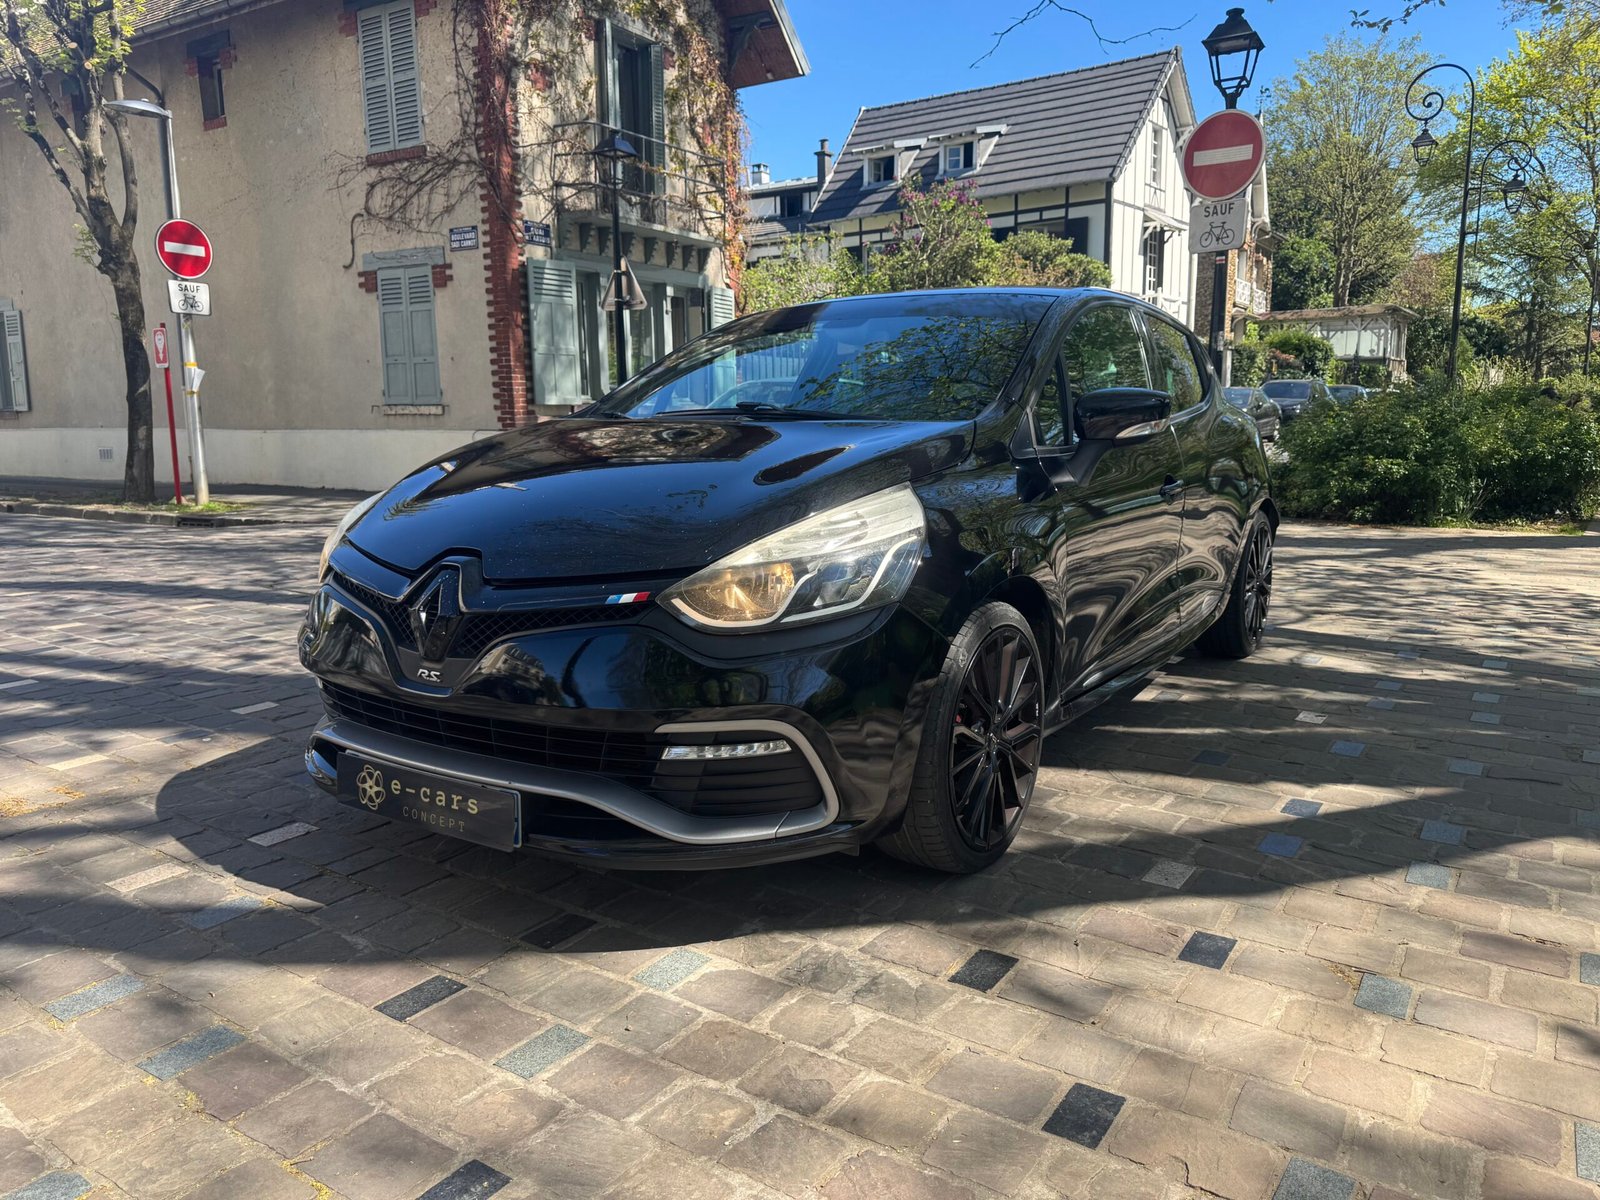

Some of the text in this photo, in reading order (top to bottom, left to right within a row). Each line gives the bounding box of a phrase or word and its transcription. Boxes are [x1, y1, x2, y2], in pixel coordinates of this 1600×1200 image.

[1204, 203, 1235, 218] SAUF
[451, 232, 475, 241] BOULEVARD
[177, 283, 200, 293] SAUF
[391, 779, 478, 814] e-cars
[403, 806, 465, 832] CONCEPT
